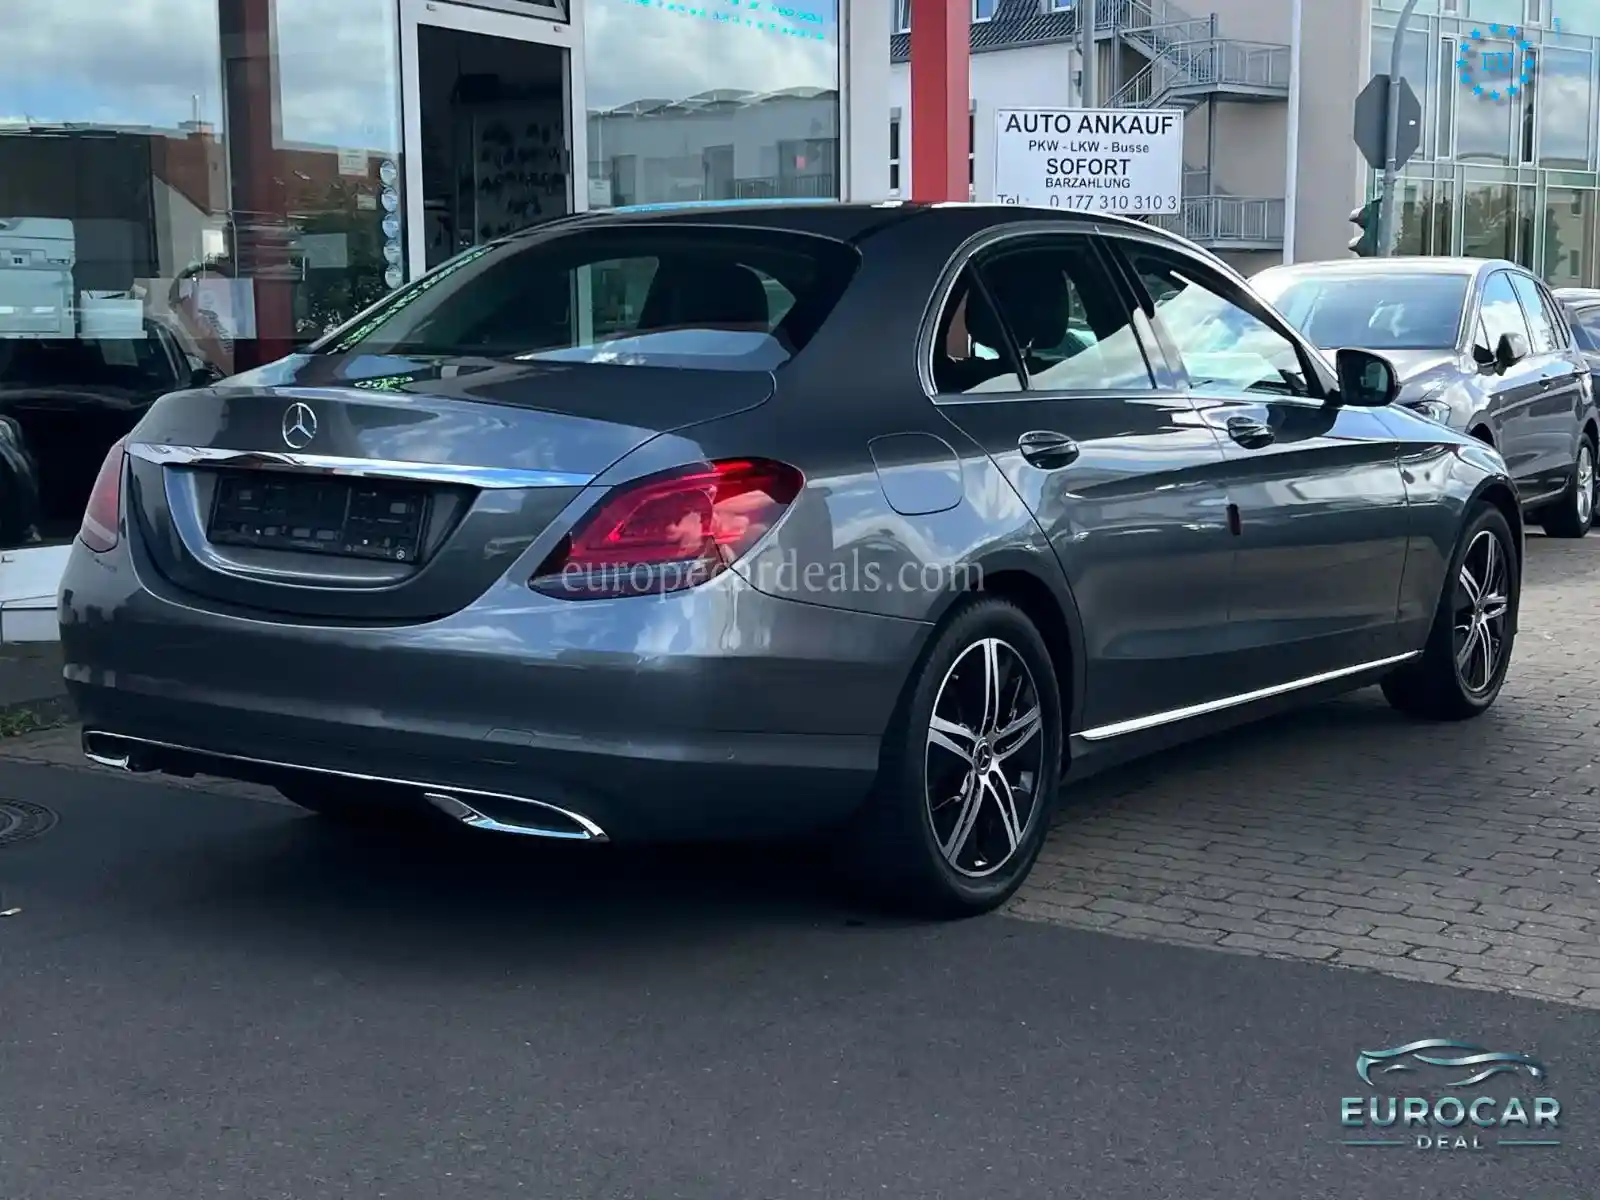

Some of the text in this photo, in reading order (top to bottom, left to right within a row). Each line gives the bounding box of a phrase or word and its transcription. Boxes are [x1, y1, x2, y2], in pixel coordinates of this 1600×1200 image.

[1005, 114, 1174, 134] AUTO ANKAUF
[1028, 139, 1059, 152] PKW
[1070, 140, 1100, 152] LKW
[1111, 141, 1149, 153] Busse
[1046, 158, 1131, 176] SOFORT
[1045, 177, 1131, 189] BARZAHLUNG
[1066, 195, 1093, 210] 177
[1100, 195, 1128, 210] 310
[1134, 195, 1162, 210] 310
[1167, 195, 1176, 210] 3
